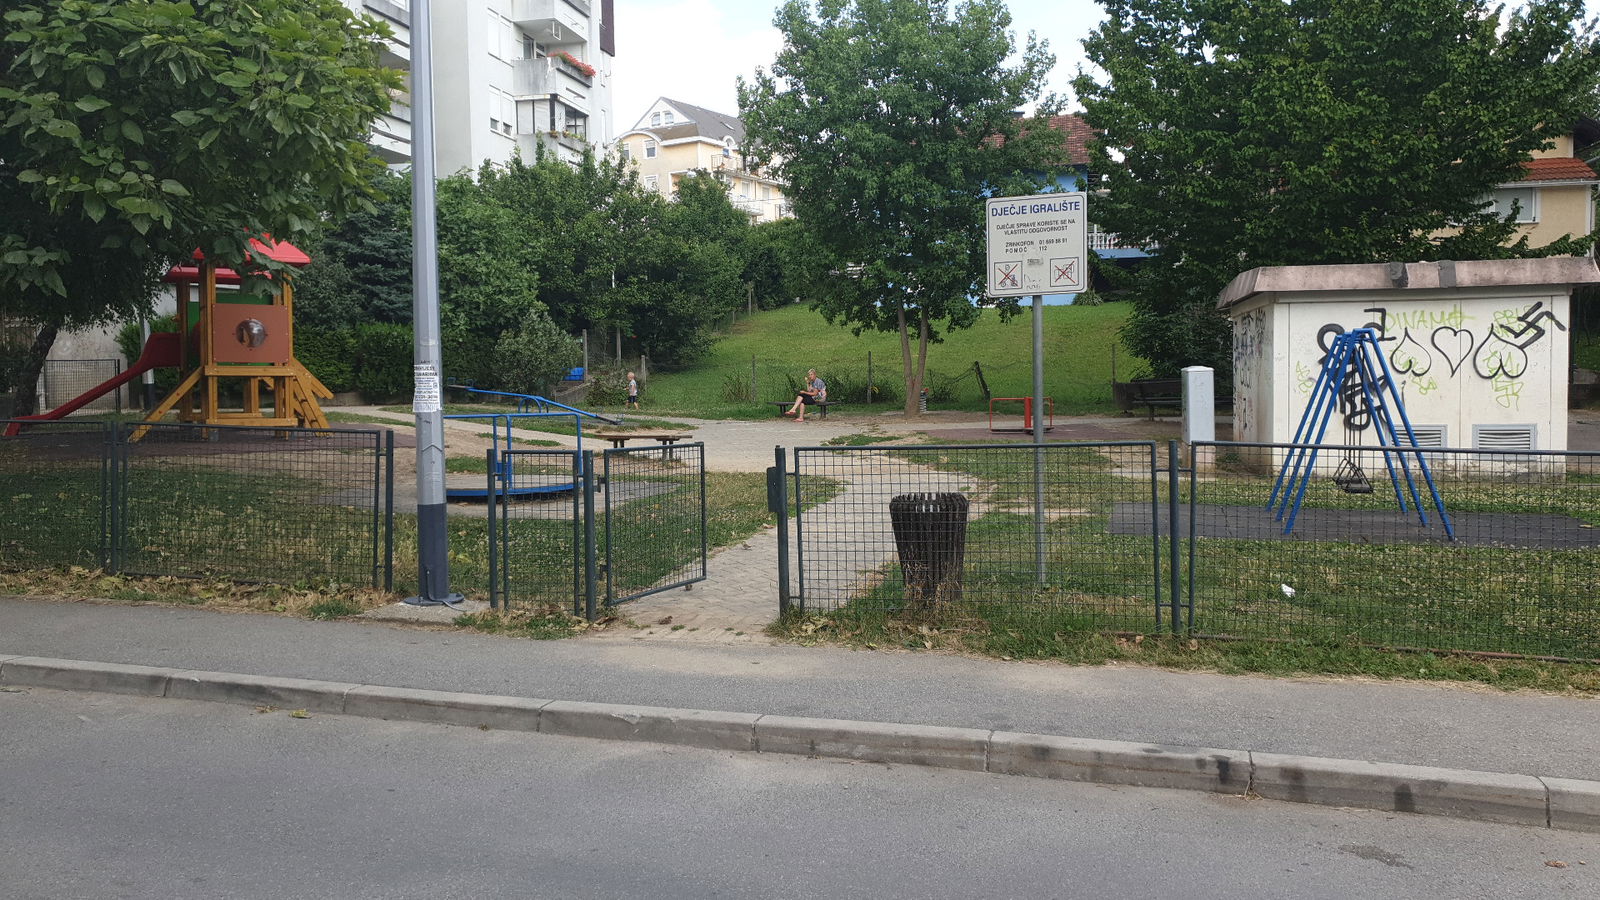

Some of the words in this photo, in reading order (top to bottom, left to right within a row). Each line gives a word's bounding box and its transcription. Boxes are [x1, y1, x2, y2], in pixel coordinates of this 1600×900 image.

[991, 204, 1028, 217] DJEČJE
[1030, 200, 1081, 214] IGRALIŠTE
[996, 222, 1015, 230] DJEČJE
[1016, 221, 1036, 229] SPRAVE
[1037, 219, 1059, 227] KORISTE
[1004, 228, 1028, 236] VLASTITU
[1028, 225, 1068, 234] ODGOVORNOST
